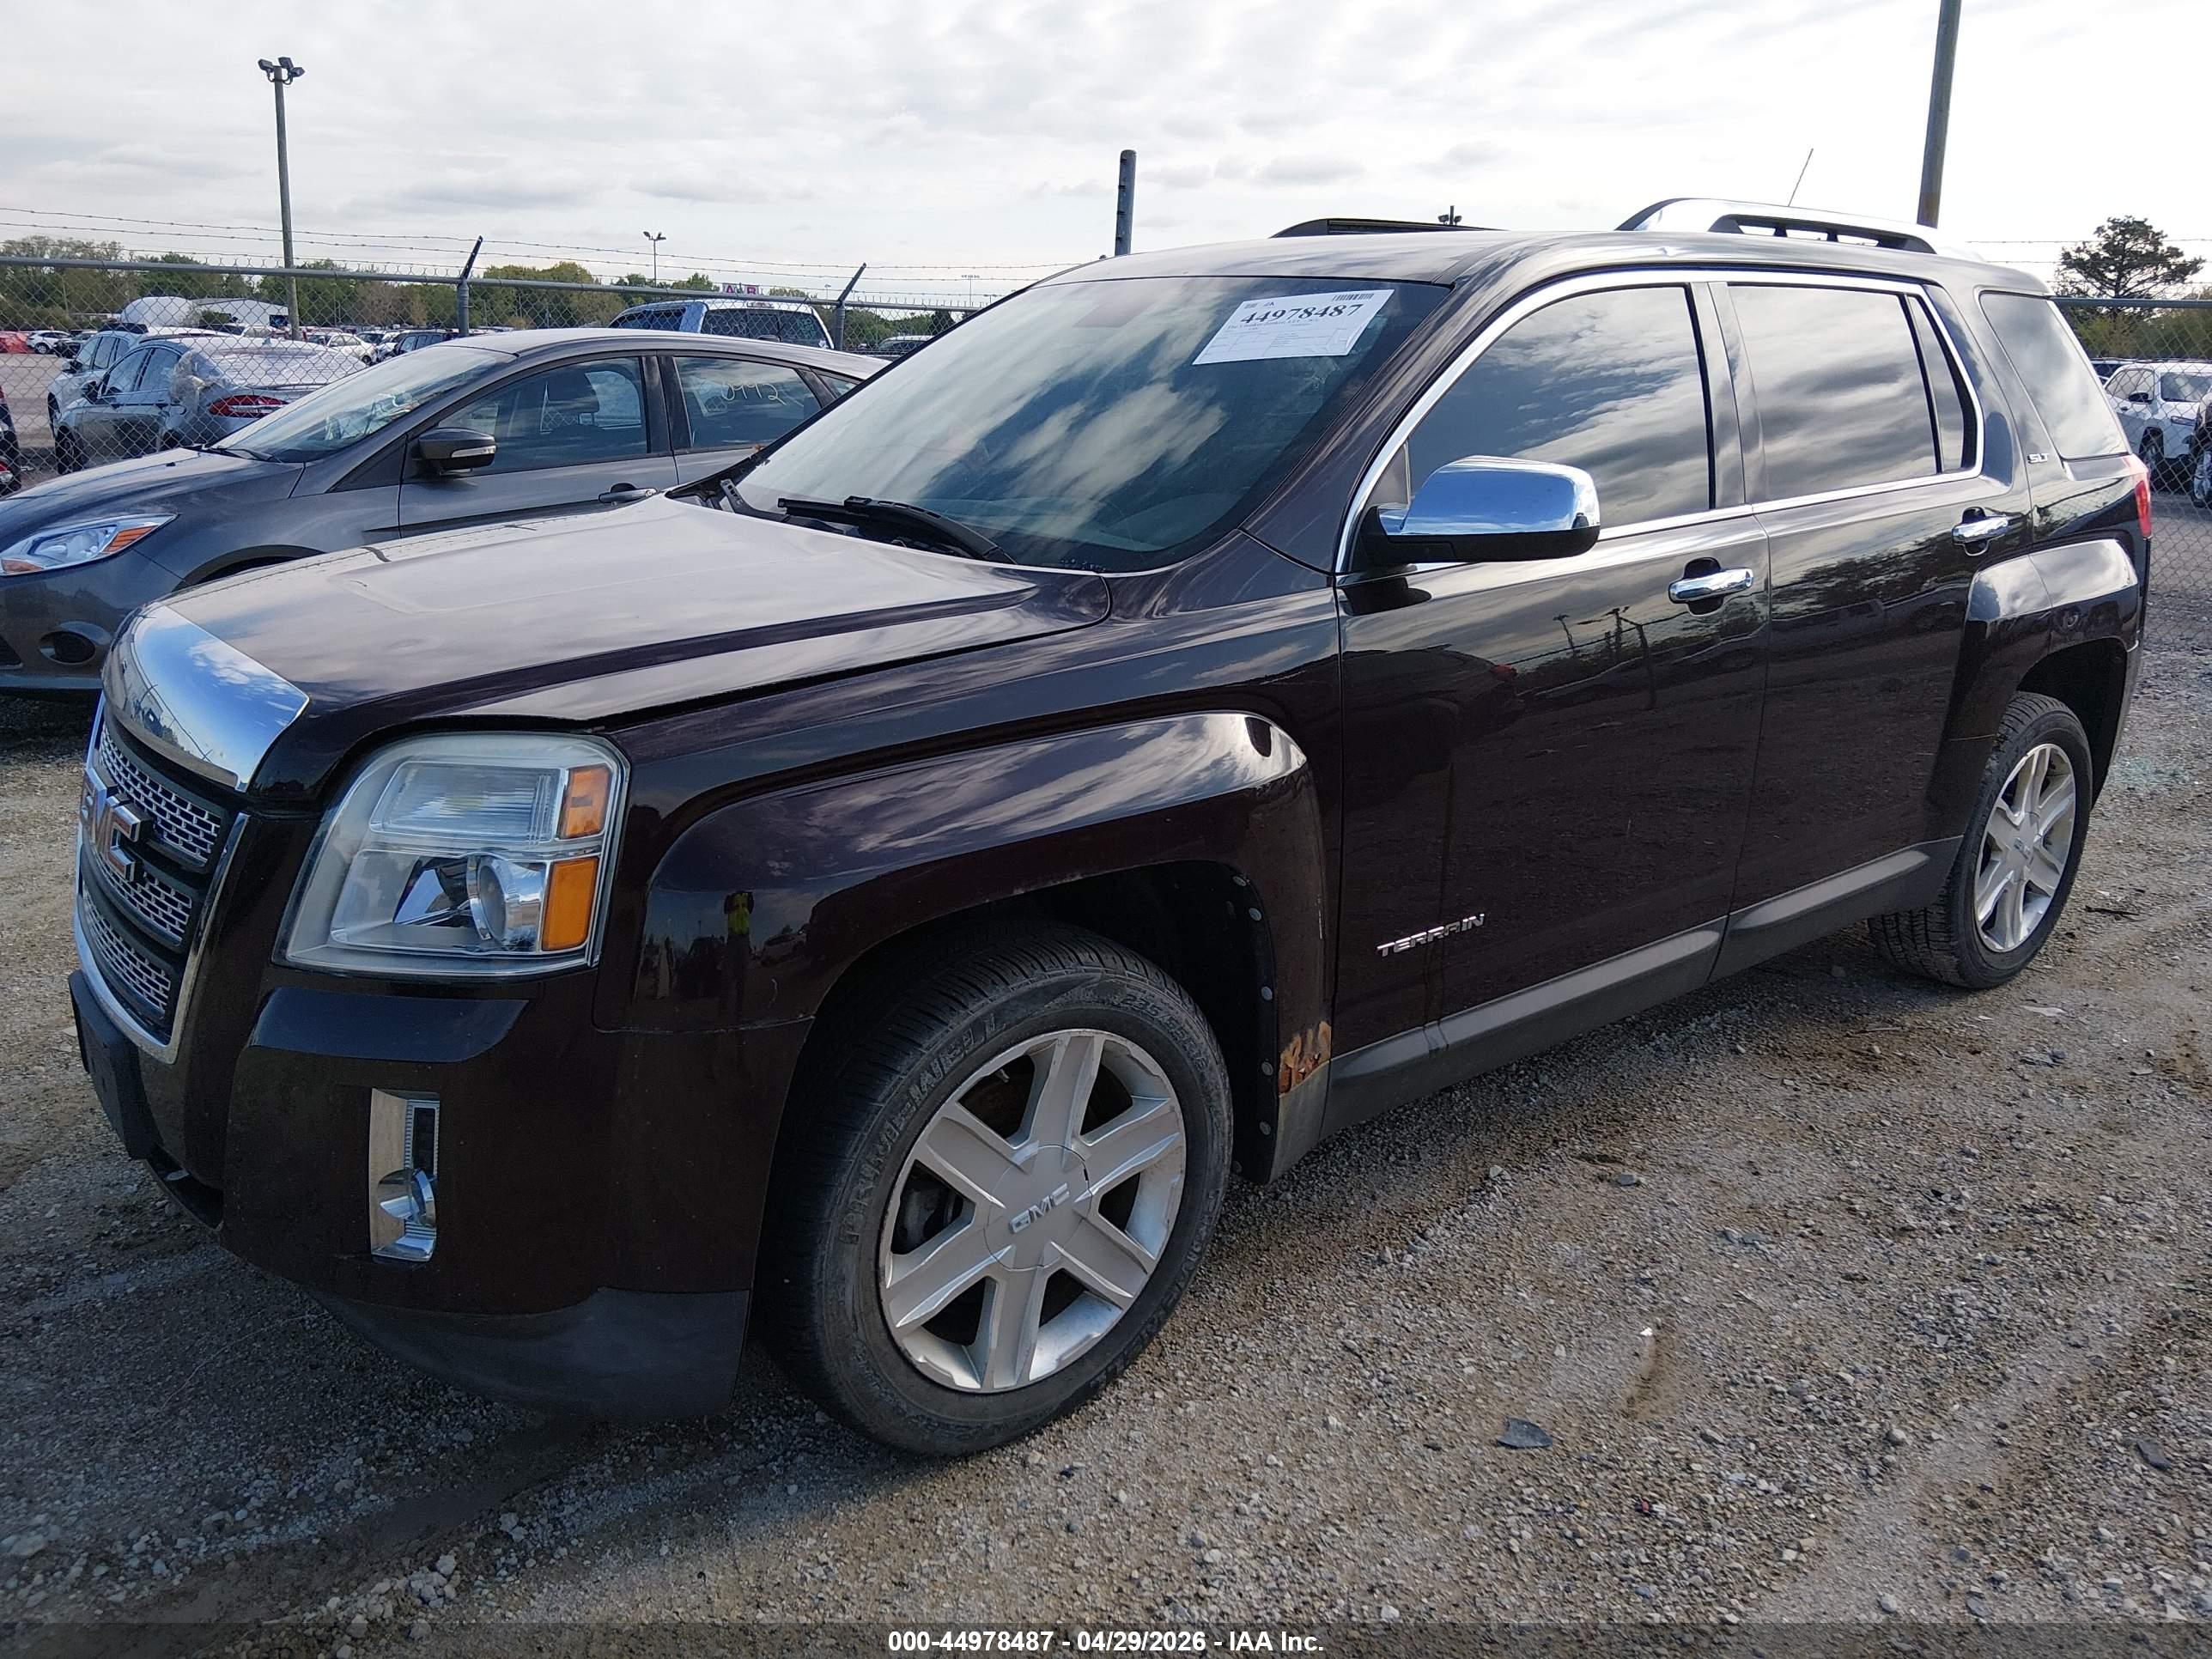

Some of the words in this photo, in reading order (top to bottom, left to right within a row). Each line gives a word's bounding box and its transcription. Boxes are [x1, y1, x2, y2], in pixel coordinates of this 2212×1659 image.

[1240, 303, 1364, 324] 44978487
[2027, 453, 2050, 465] SLT
[1376, 913, 1485, 957] TERRAIN
[1008, 1182, 1070, 1234] GMC
